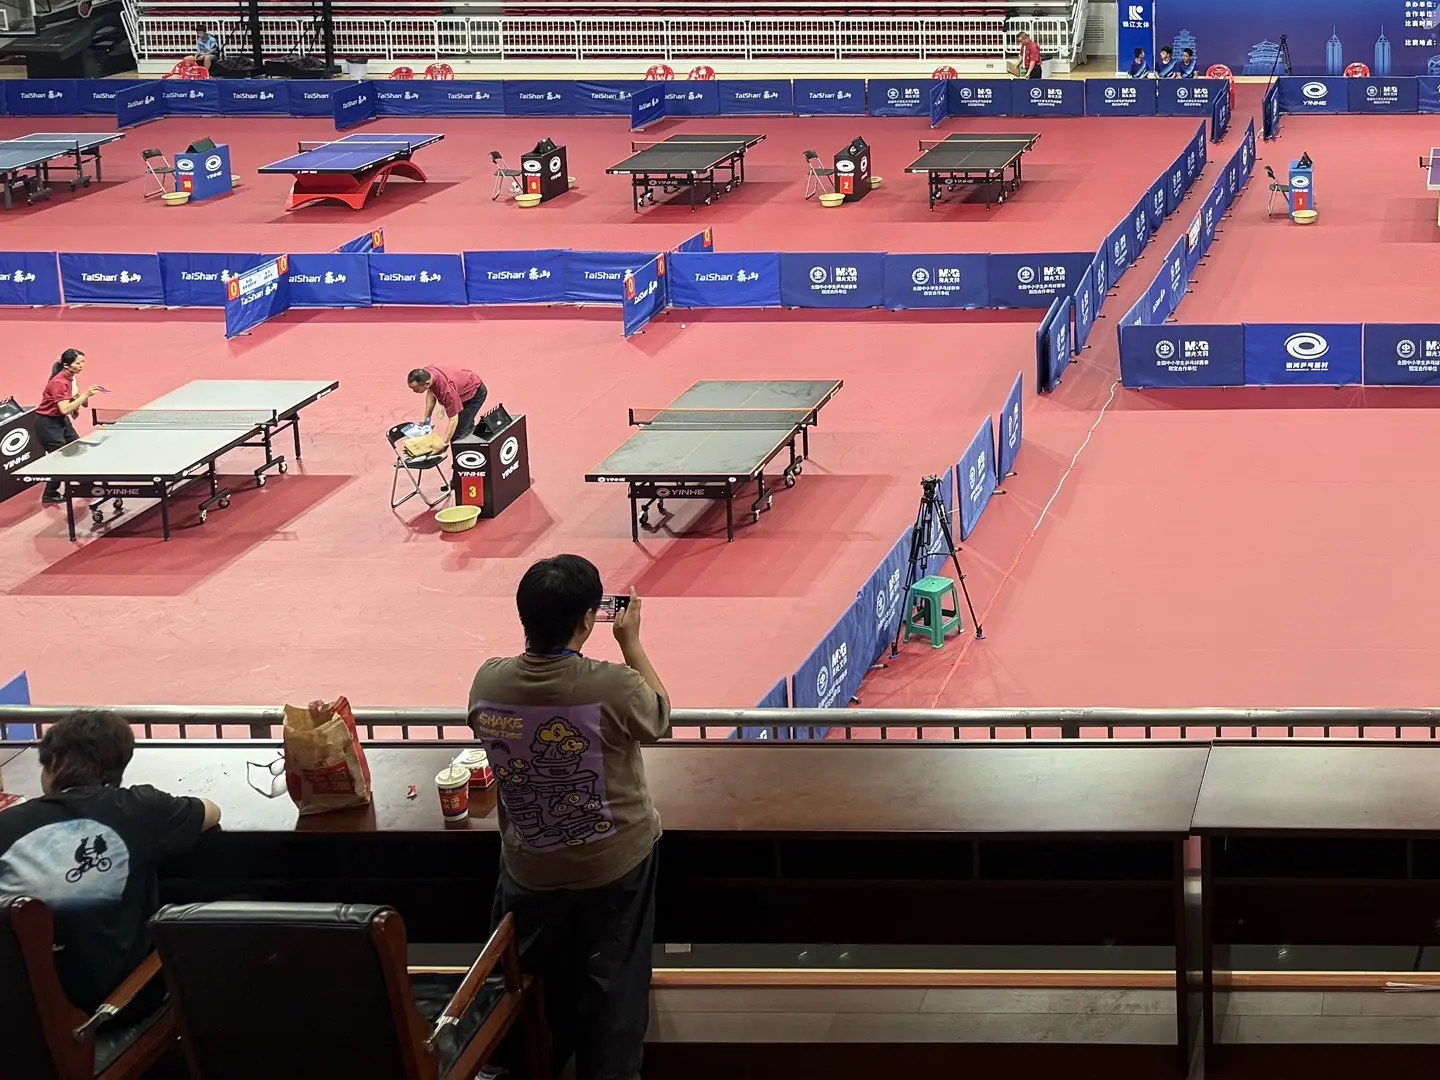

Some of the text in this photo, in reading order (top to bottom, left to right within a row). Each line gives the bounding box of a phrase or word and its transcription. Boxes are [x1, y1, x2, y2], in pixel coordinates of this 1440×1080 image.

[183, 180, 192, 188] 10
[843, 181, 849, 189] 2
[374, 231, 380, 243] 0
[705, 229, 710, 240] 0
[281, 257, 287, 269] 0
[659, 260, 664, 270] 0
[182, 272, 218, 280] TaiShan
[487, 271, 525, 279] TaiShan
[835, 268, 857, 276] M&G
[937, 269, 959, 278] M&G
[1044, 267, 1066, 276] M&G
[379, 273, 416, 281] TaiShan
[230, 282, 237, 296] 0
[628, 279, 633, 293] 0
[241, 288, 264, 307] TaiShan
[1185, 341, 1209, 351] M&G
[3, 452, 31, 470] YINHE
[501, 460, 520, 480] YINHE
[469, 486, 476, 497] 3
